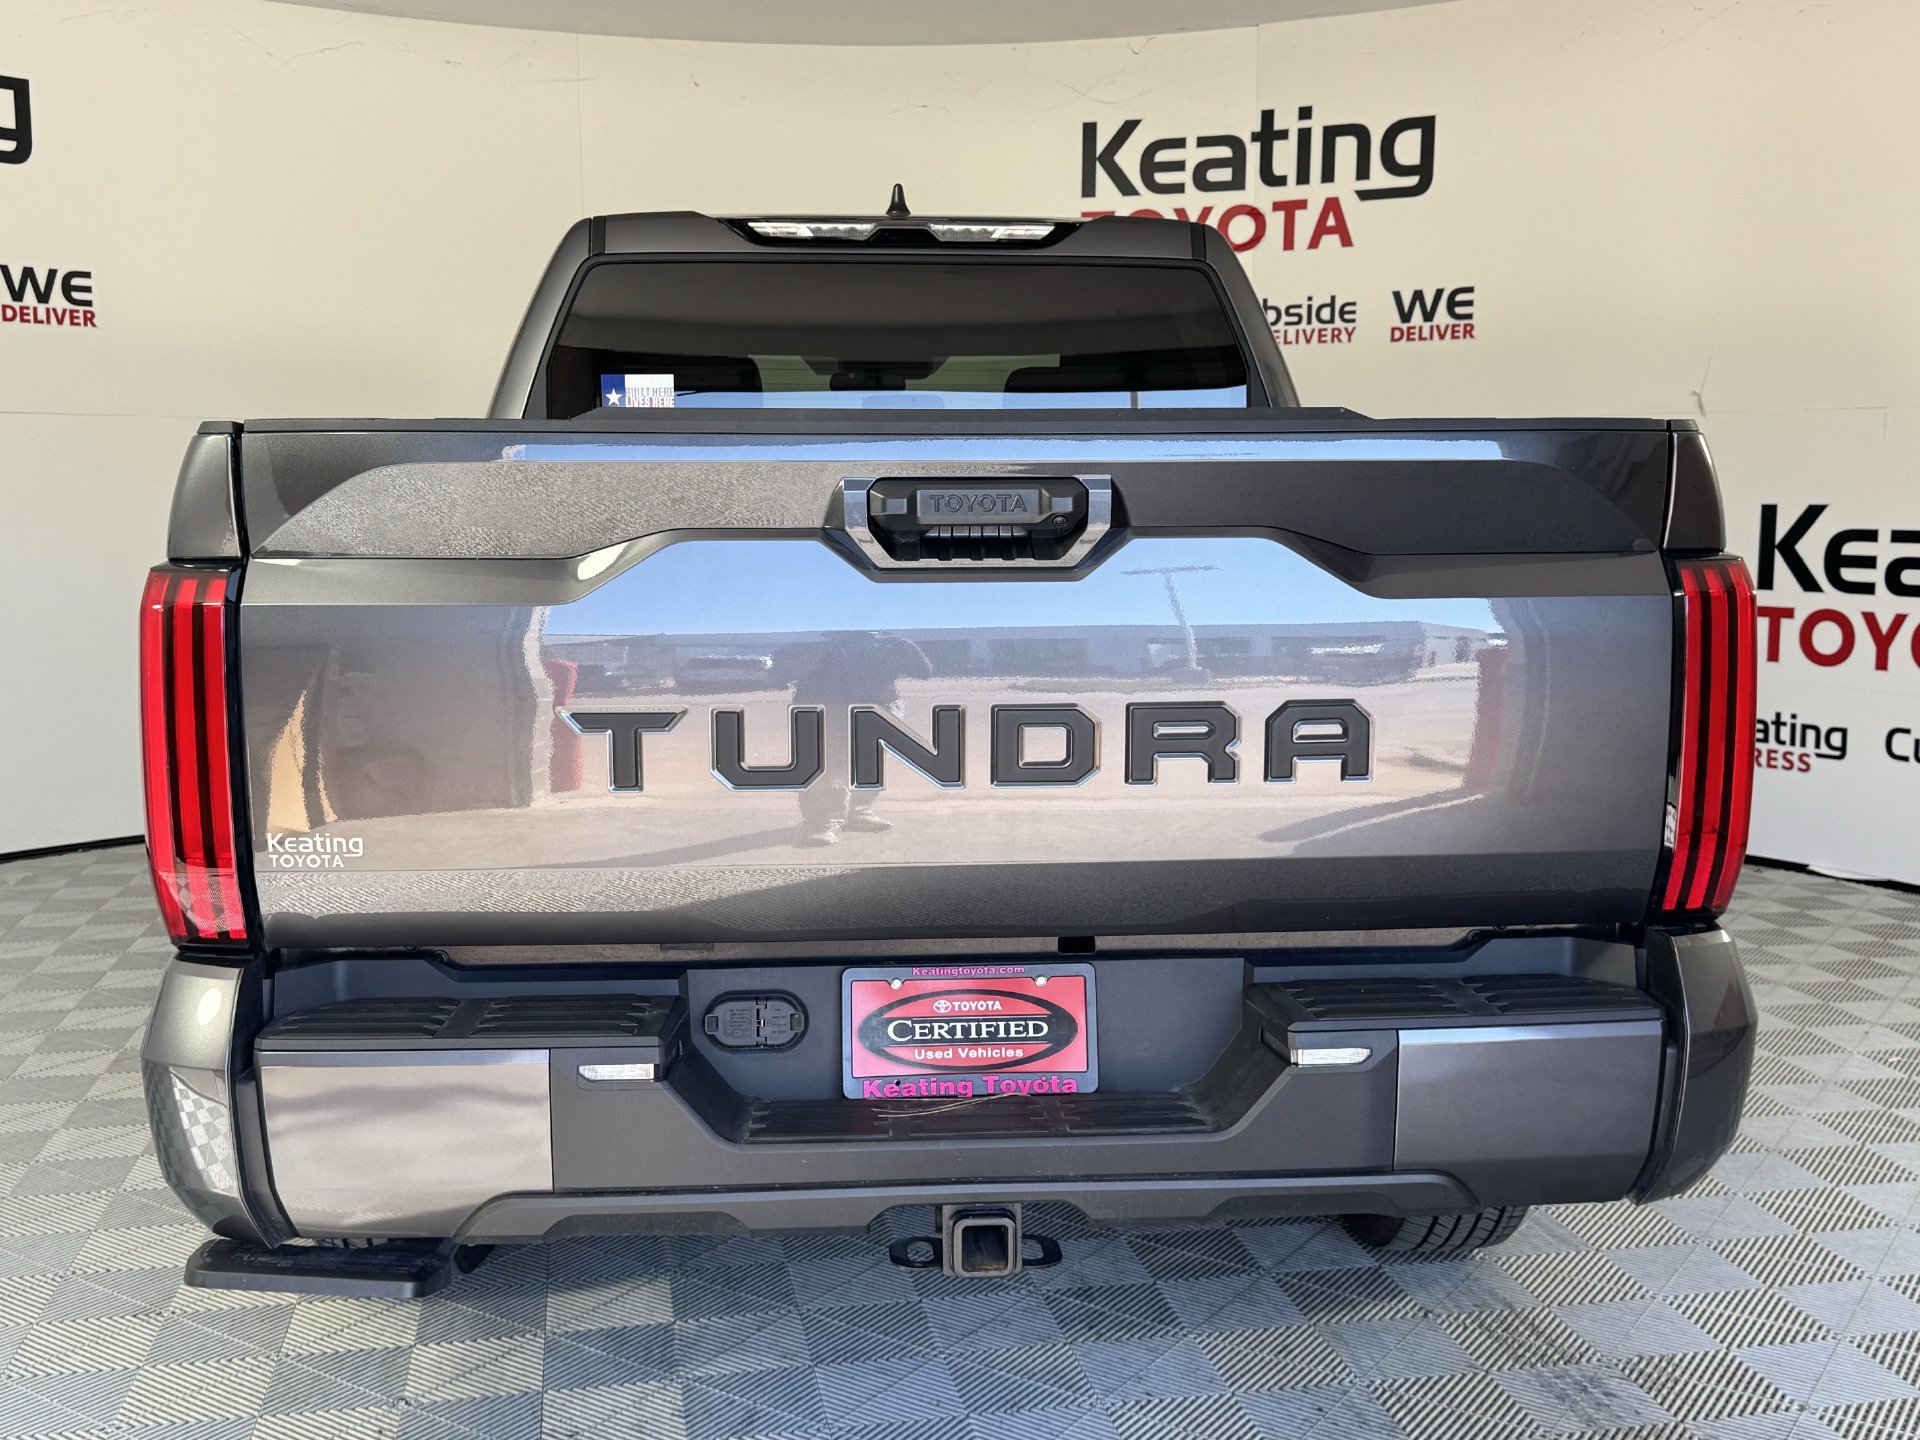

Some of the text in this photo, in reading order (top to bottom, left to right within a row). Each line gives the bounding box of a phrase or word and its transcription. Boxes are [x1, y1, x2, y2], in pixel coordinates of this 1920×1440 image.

[1081, 105, 1436, 201] Keating
[1081, 196, 1354, 253] OTA
[0, 264, 93, 307] WE
[1, 304, 97, 328] DELIVER
[1392, 286, 1475, 324] WE
[1390, 323, 1475, 343] DELIVER
[652, 387, 674, 398] HERE
[652, 397, 674, 408] HERE
[929, 494, 1027, 512] TOYOTA
[1757, 606, 1920, 672] TOY
[556, 699, 1375, 793] TUNDRA
[266, 833, 364, 858] Keating
[269, 854, 344, 868] TOYOTA
[912, 966, 1025, 977] Keatingtoyota.com
[952, 1001, 1002, 1012] TOYOTA
[914, 1047, 1024, 1060] Used Vehicles
[863, 1075, 1078, 1099] Keating Toyota
